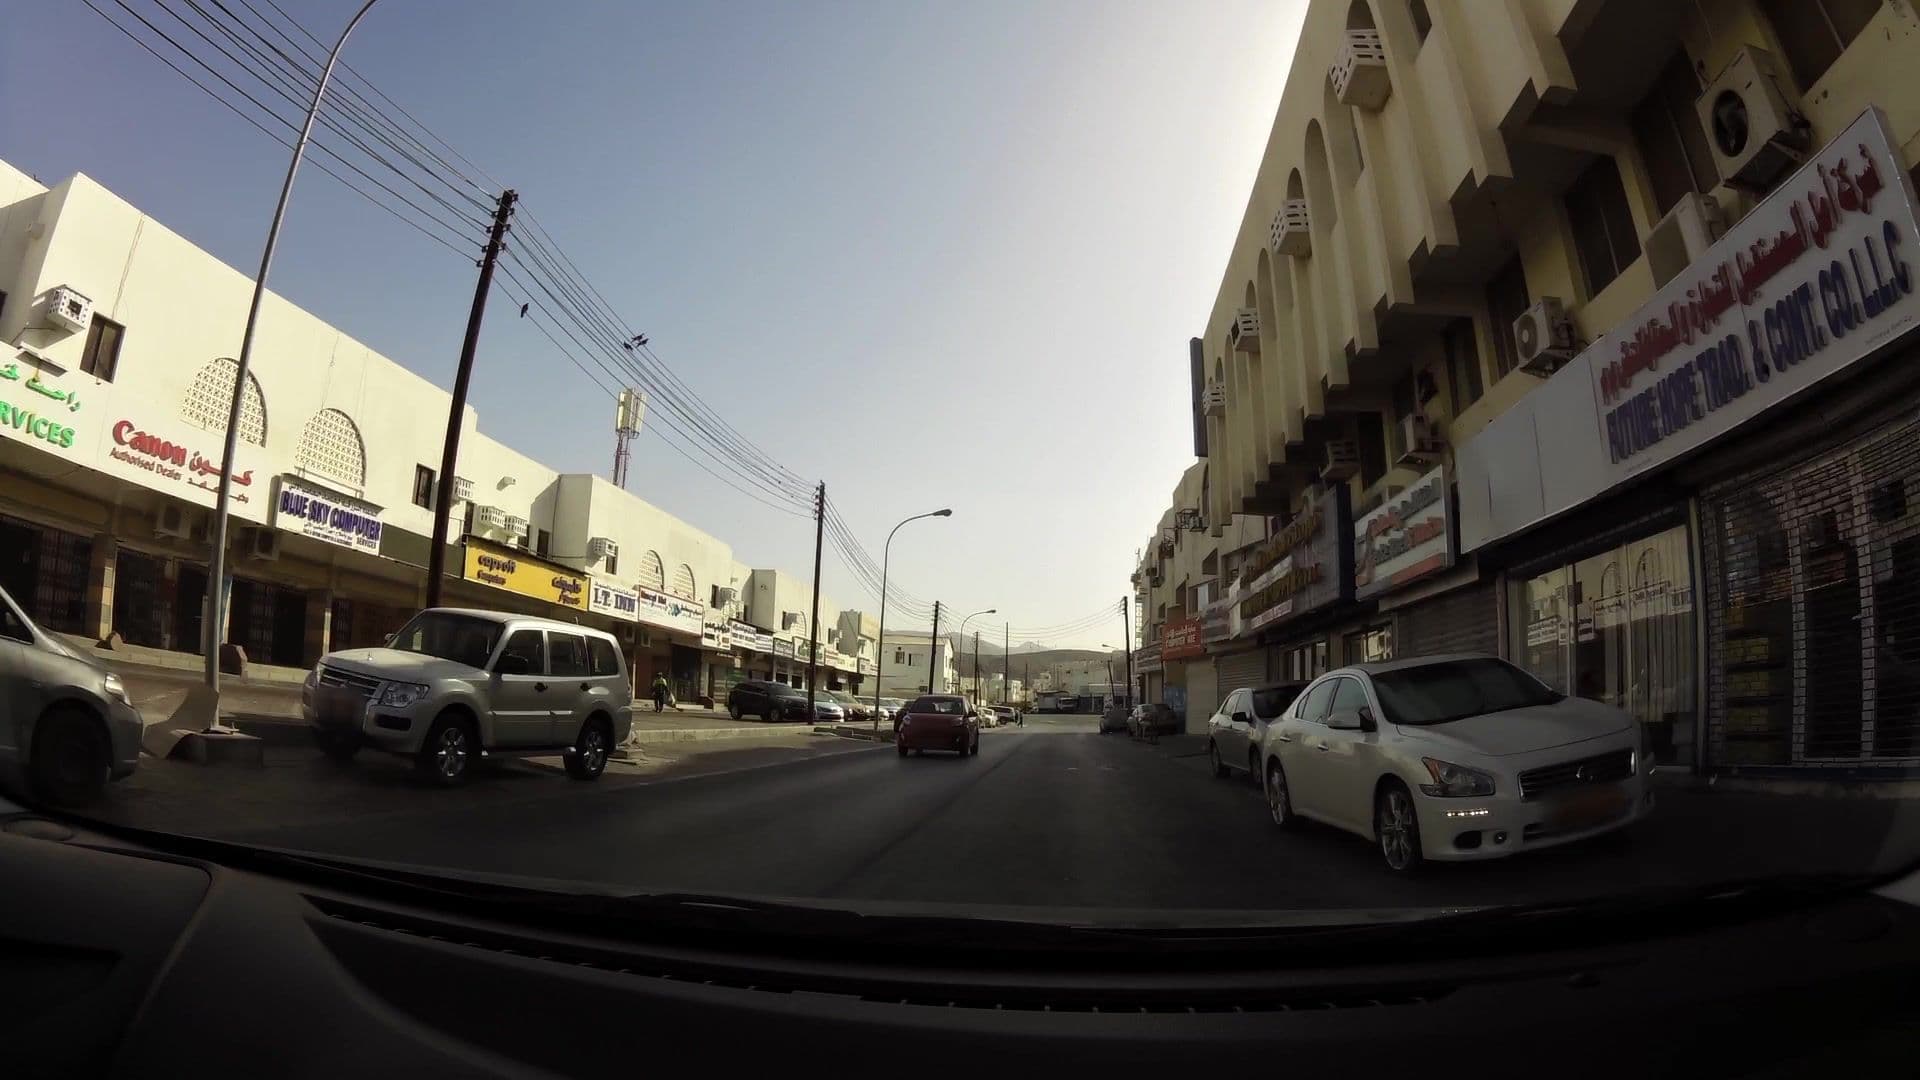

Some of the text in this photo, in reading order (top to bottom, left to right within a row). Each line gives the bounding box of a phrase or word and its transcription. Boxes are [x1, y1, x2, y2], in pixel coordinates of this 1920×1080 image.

[1831, 143, 1884, 214] شركة
[1606, 387, 1664, 464] FUTURE
[1657, 360, 1704, 437] HOPE
[1696, 334, 1755, 412] TRAD.
[1749, 320, 1770, 383] &
[1764, 282, 1828, 372] CONT.
[1818, 260, 1864, 338] CO.
[110, 447, 182, 481] Authorised Dealer
[112, 421, 187, 466] Canon
[279, 490, 309, 518] BLUE
[308, 500, 331, 526] SKY
[330, 508, 381, 540] COMPUTER
[614, 593, 635, 612] INN
